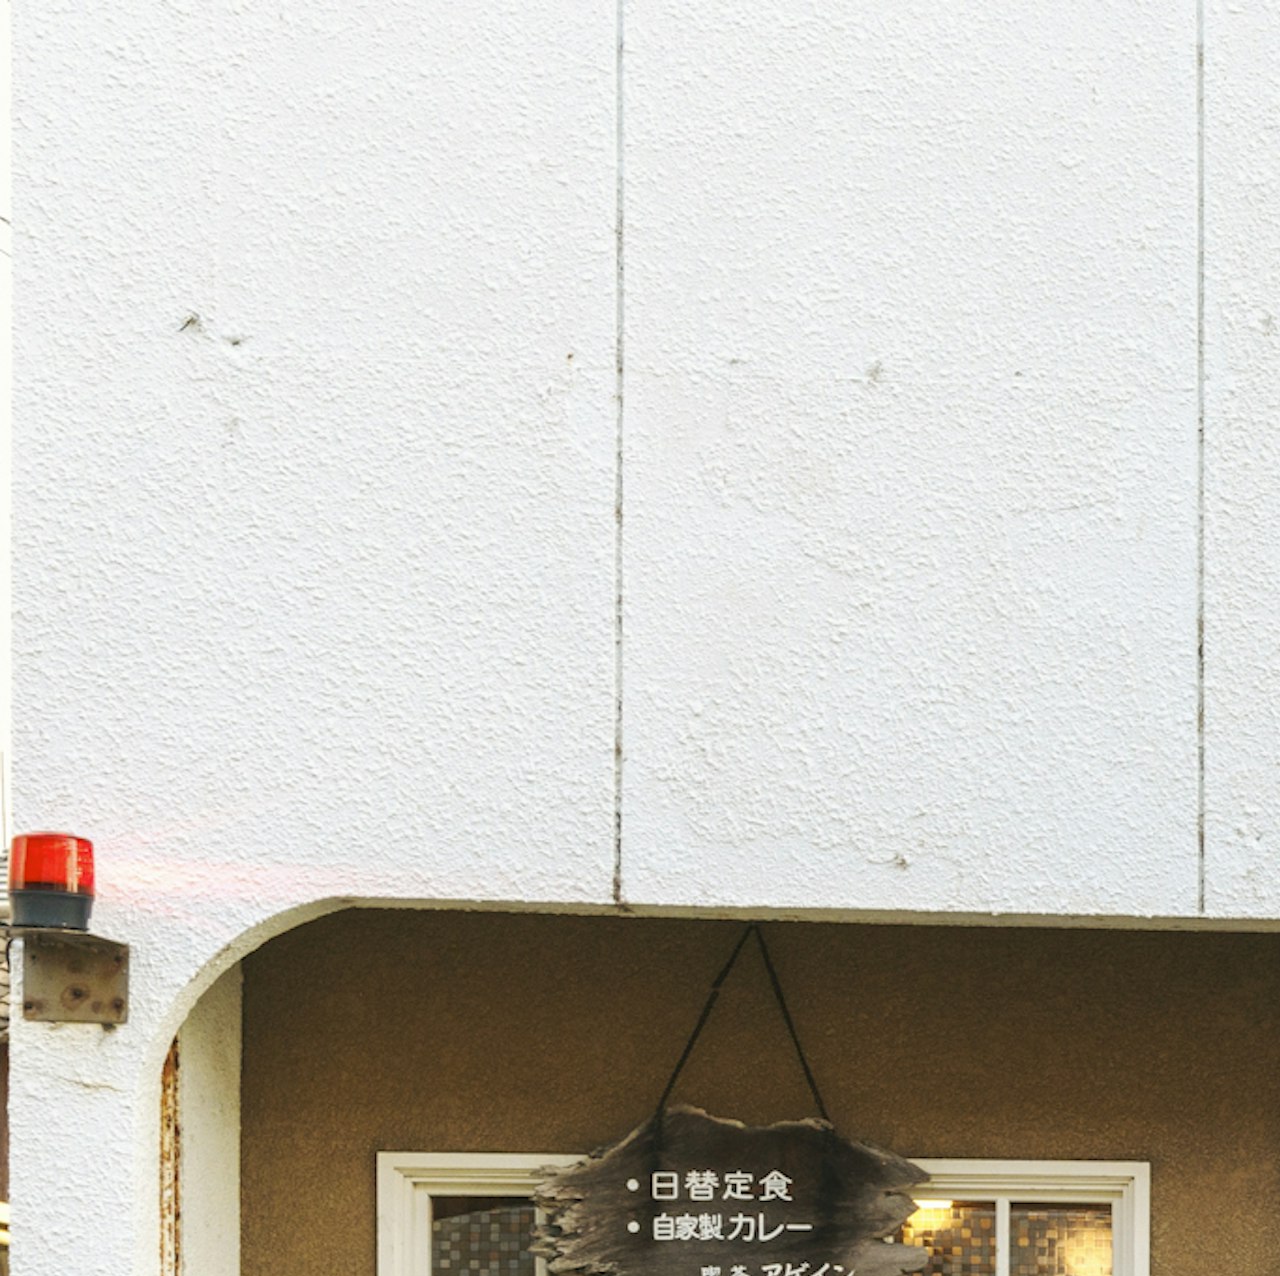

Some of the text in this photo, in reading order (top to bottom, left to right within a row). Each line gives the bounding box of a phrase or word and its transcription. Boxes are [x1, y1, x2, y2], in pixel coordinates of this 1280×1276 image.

[651, 1170, 793, 1202] 日替定食
[652, 1212, 813, 1242] 自家製カレー
